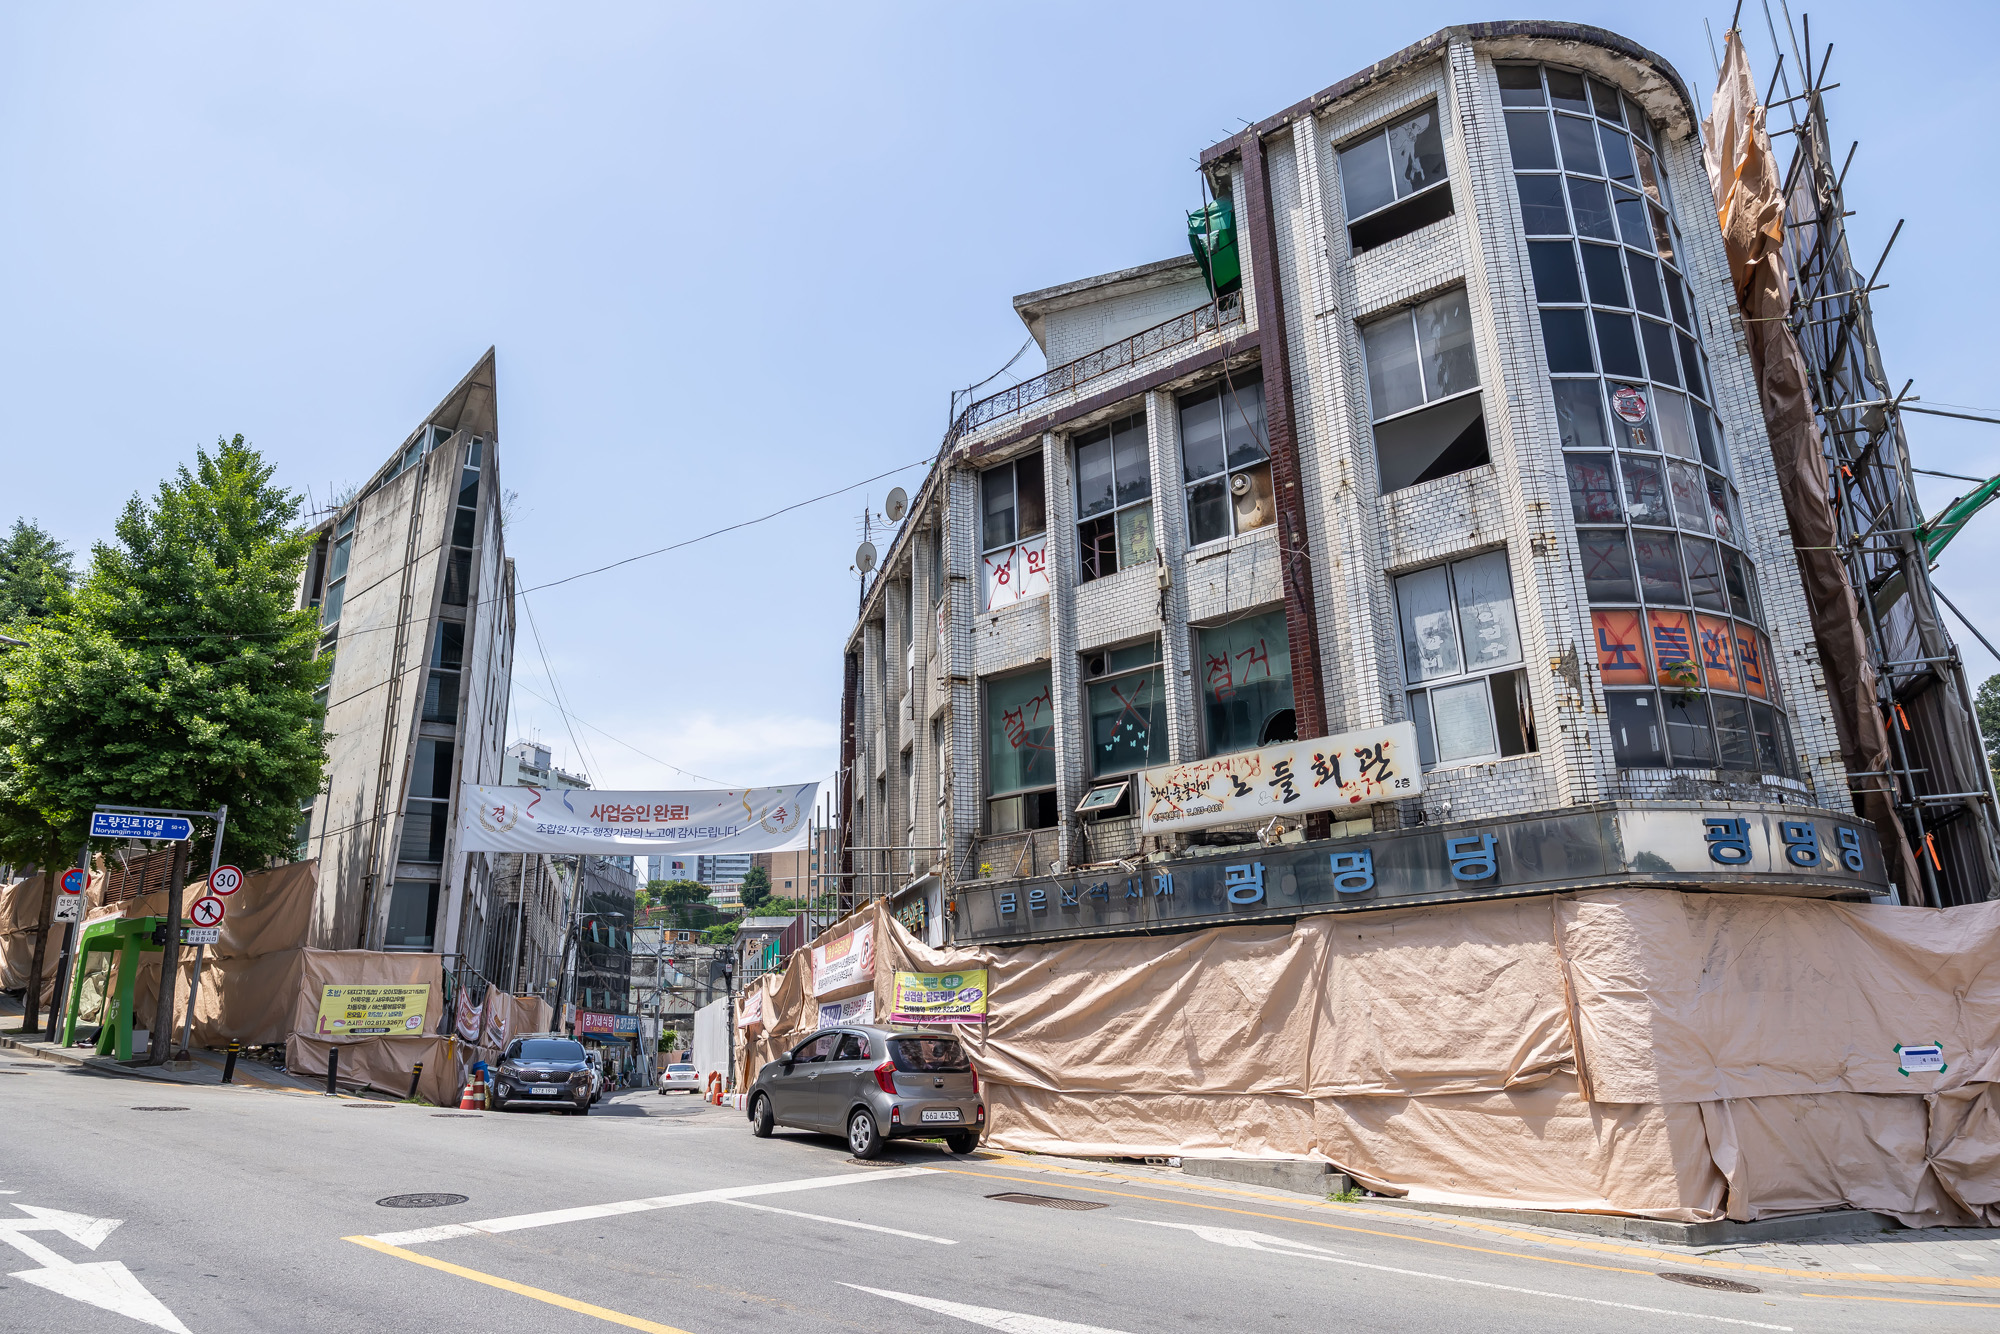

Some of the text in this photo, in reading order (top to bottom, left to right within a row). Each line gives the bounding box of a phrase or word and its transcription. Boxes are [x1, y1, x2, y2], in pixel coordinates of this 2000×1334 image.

[1598, 626, 1762, 684] 노들회관
[1205, 638, 1271, 703] 철거
[1002, 685, 1054, 749] 철거
[1231, 742, 1394, 804] 노들회관
[1394, 777, 1411, 790] 2층
[491, 805, 506, 823] 경
[590, 803, 690, 823] 사업승인 완료!
[772, 806, 788, 824] 축
[95, 827, 142, 836] Noryangjin-ro
[96, 816, 165, 831] 노량진로18길
[645, 827, 676, 839] 노고에
[678, 825, 741, 839] 감사드립니다.
[1704, 817, 1865, 872] 광명당
[671, 869, 686, 877] 우성
[1225, 832, 1499, 905] 광명당
[216, 873, 237, 888] 30
[326, 988, 342, 997] 초밥
[585, 1013, 614, 1028] 정가네식당
[940, 1111, 956, 1120] 4433
